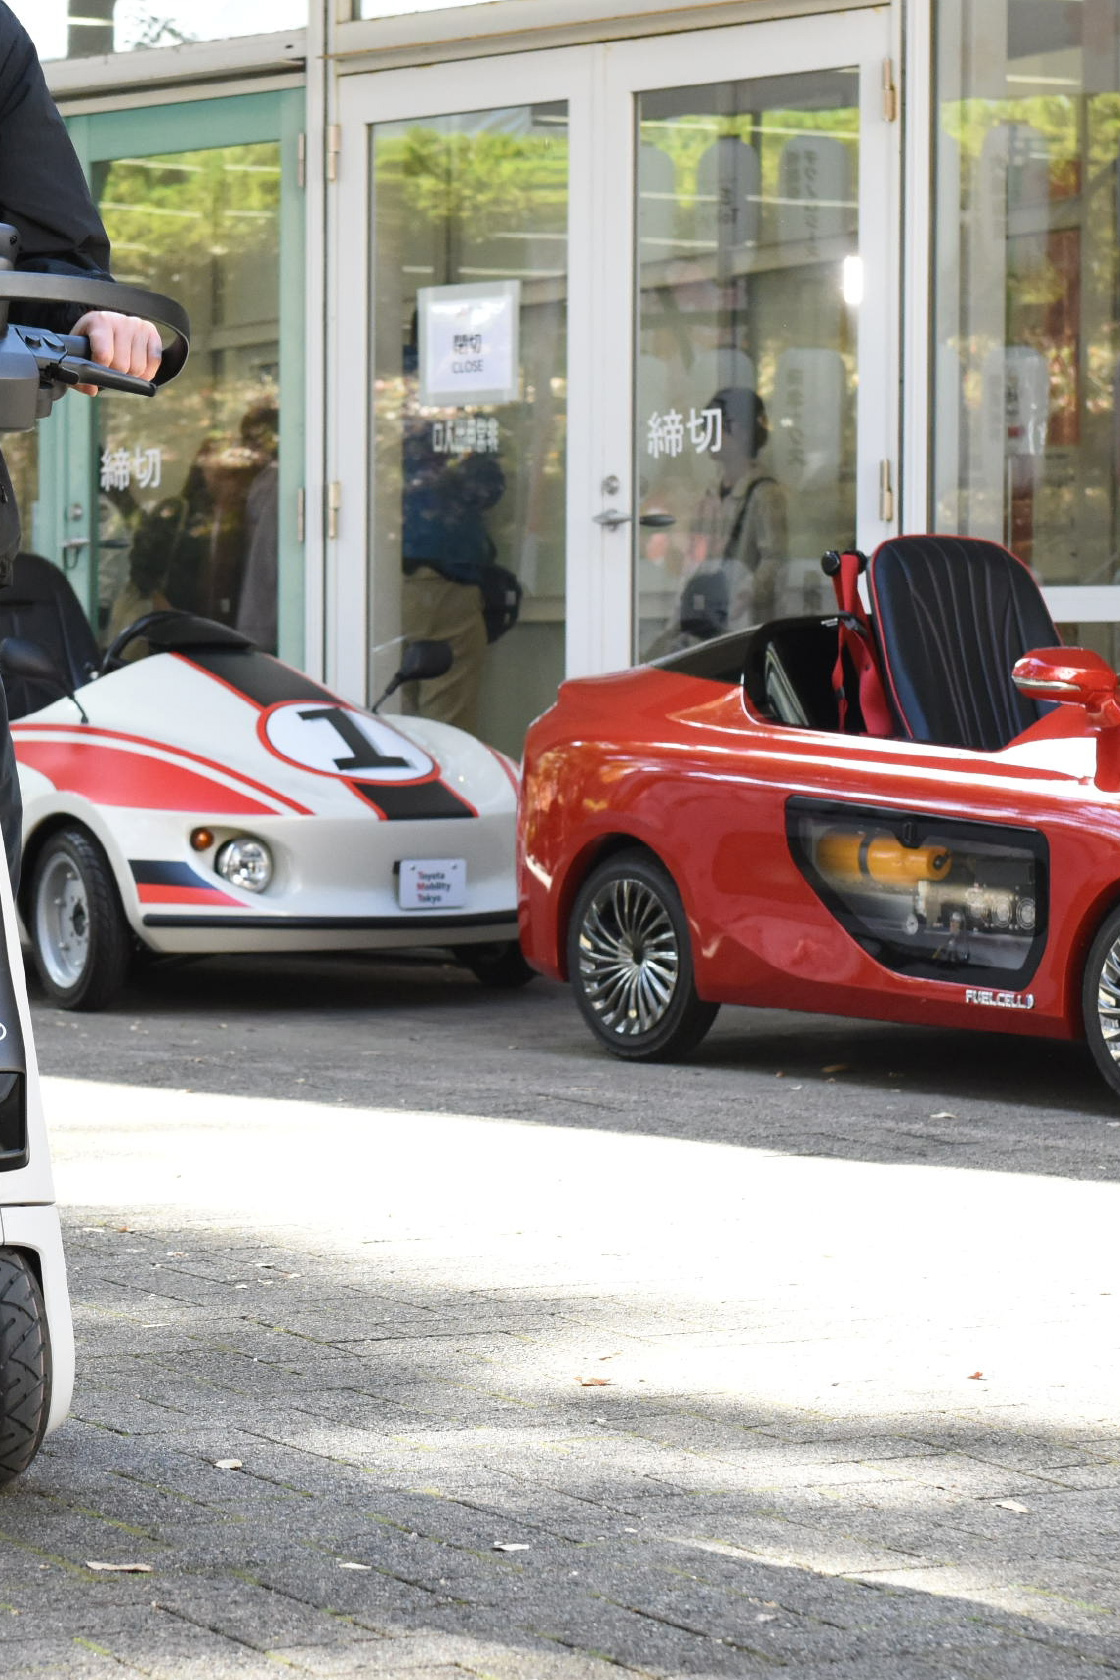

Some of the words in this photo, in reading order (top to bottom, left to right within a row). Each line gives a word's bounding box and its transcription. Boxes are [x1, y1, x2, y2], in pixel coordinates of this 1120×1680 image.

[451, 360, 484, 374] CLOSE
[647, 406, 723, 460] 締切
[100, 446, 162, 492] 締切
[295, 707, 414, 771] 1
[417, 871, 445, 881] Toyota
[416, 882, 451, 893] Mobility
[417, 893, 442, 905] Tokyo
